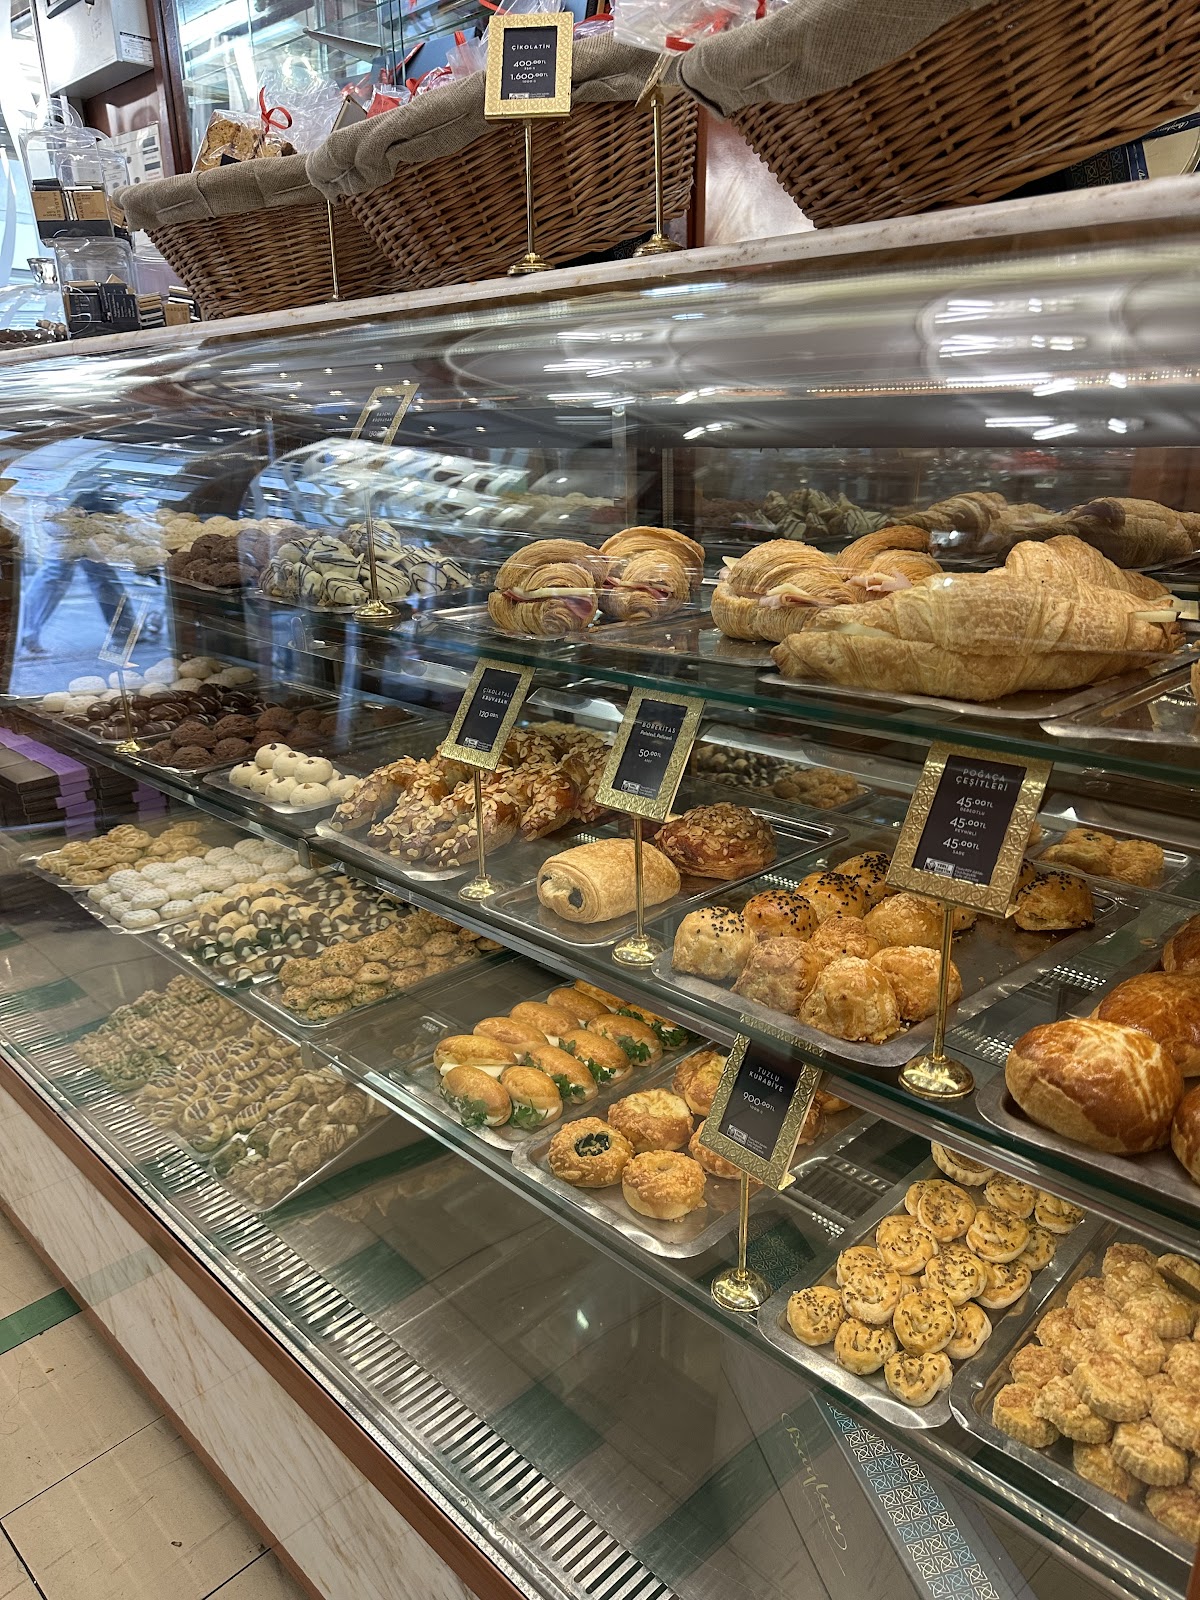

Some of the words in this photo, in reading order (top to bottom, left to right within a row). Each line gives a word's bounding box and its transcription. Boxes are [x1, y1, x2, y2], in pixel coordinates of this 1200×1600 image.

[963, 767, 1005, 783] POĞAÇA
[955, 775, 1008, 792] ÇEŞİTLERİ
[748, 1071, 784, 1092] KURABİYE
[758, 1066, 780, 1081] TUZLU
